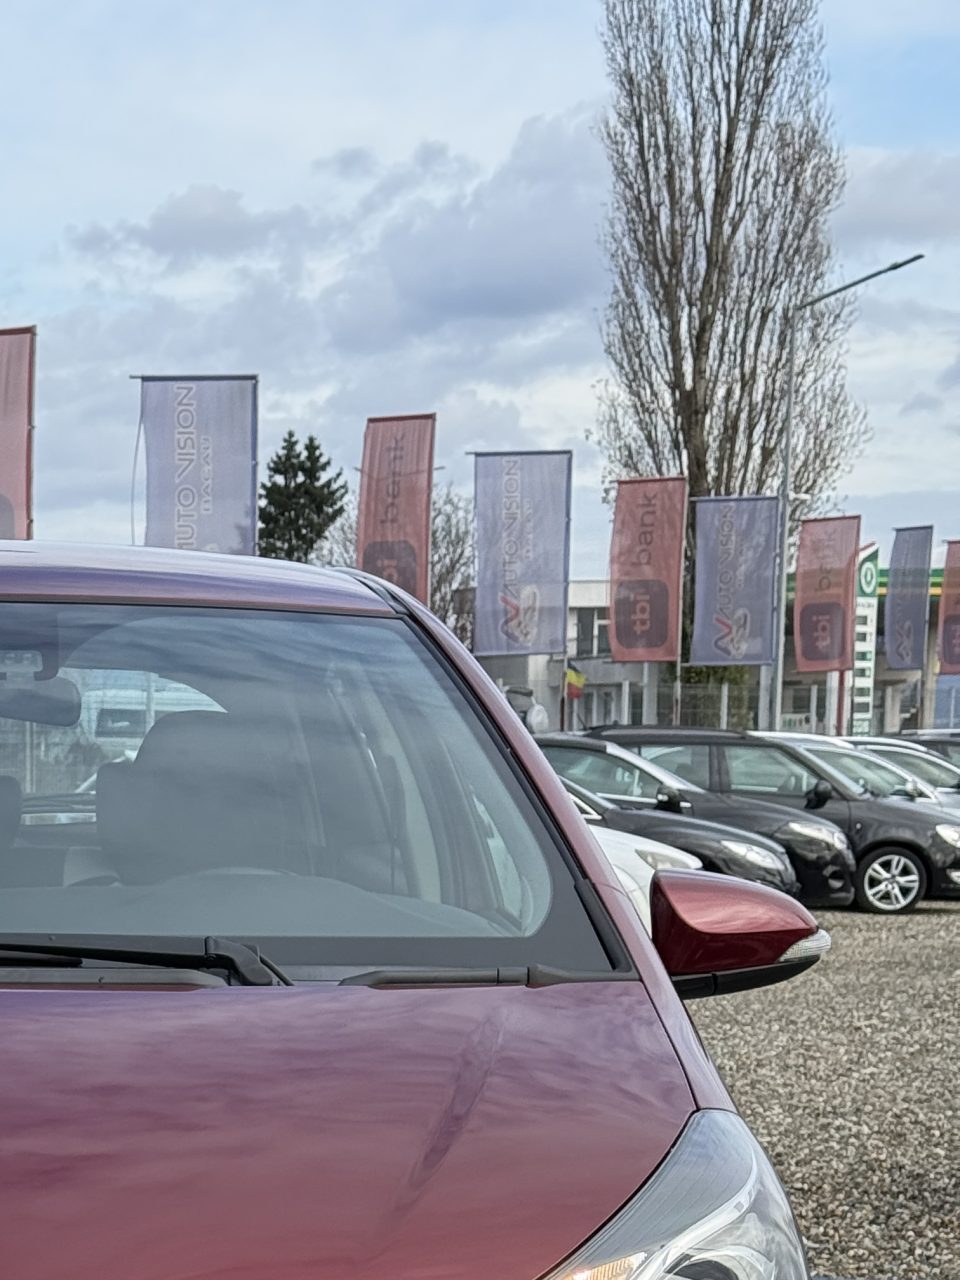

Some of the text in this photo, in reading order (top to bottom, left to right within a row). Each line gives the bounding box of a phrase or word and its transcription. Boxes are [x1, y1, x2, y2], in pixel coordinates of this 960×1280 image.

[174, 384, 196, 482] VISION
[503, 459, 520, 534] VISION
[503, 539, 520, 599] AUTO
[630, 491, 658, 635] tbi bank
[812, 615, 831, 649] tbi
